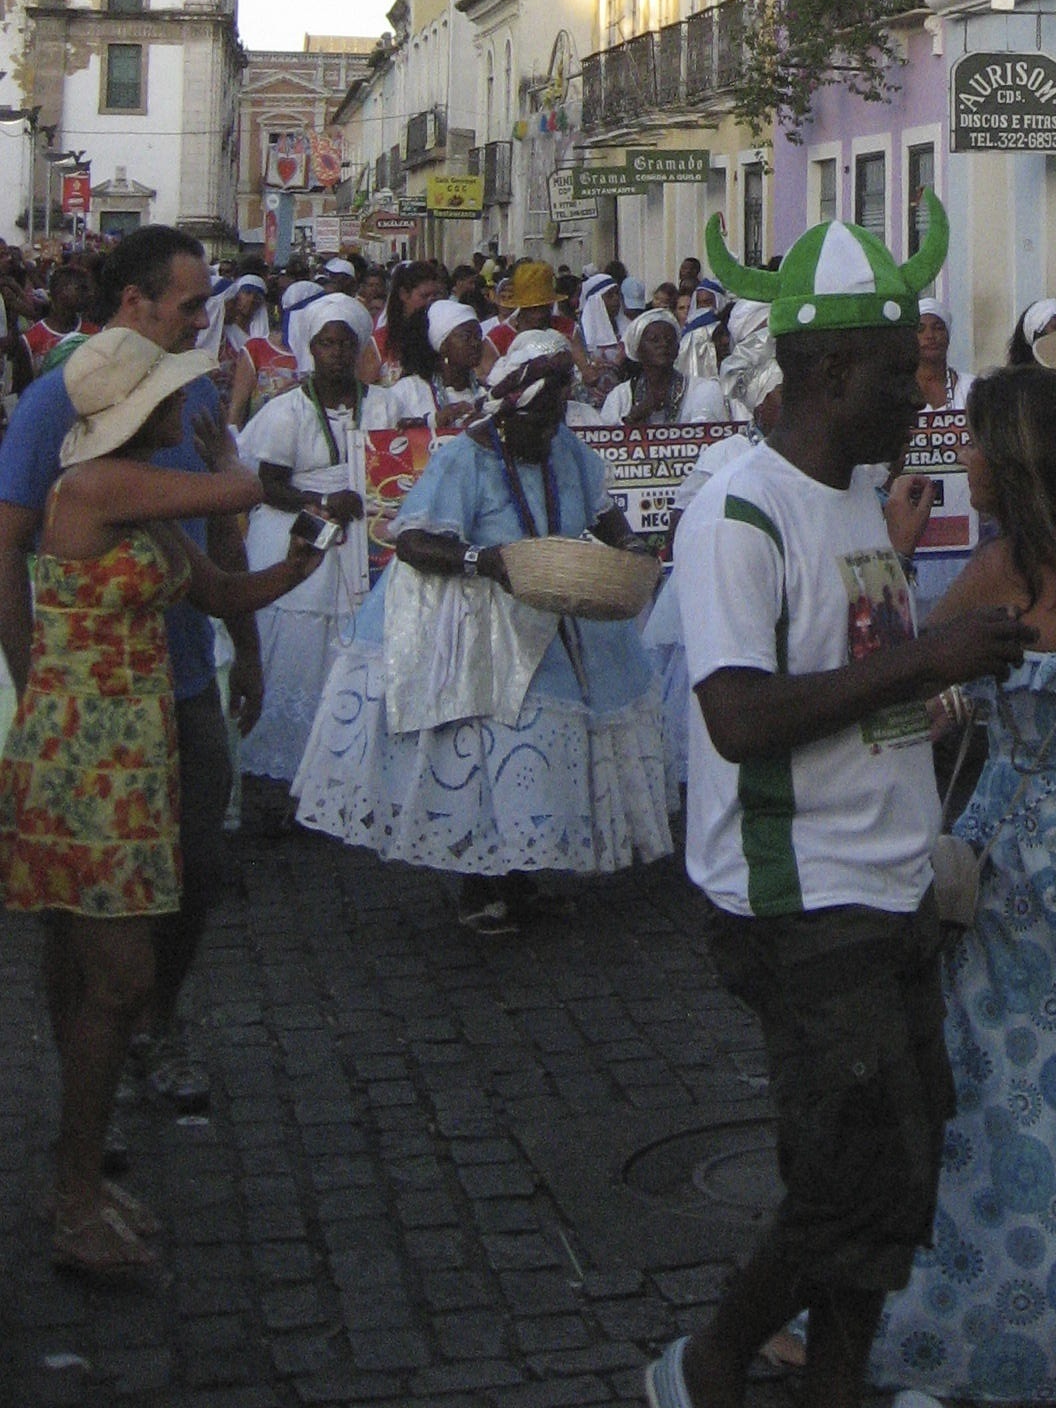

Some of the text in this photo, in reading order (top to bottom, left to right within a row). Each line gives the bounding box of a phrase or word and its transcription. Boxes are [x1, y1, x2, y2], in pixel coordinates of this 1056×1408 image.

[960, 114, 1008, 128] DISCOS
[1011, 115, 1021, 128] E
[634, 154, 704, 170] Gramado
[581, 186, 636, 196] RESTAURANTE
[629, 429, 642, 441] A
[646, 426, 705, 440] TODOS
[710, 425, 733, 437] OS
[919, 416, 928, 428] E
[932, 414, 967, 428] APO
[632, 446, 646, 460] A
[932, 431, 958, 446] DO
[656, 459, 671, 479] À
